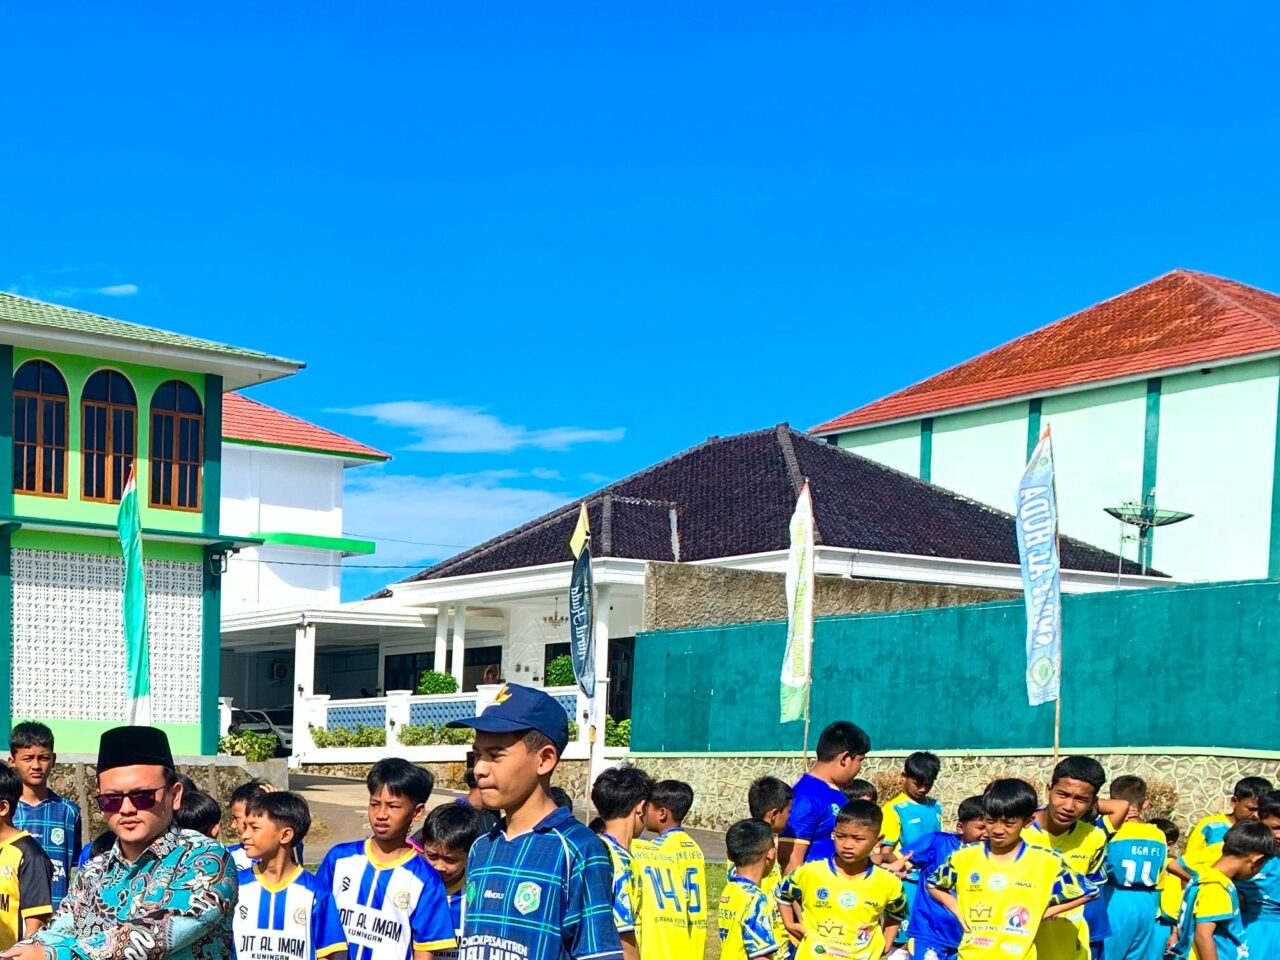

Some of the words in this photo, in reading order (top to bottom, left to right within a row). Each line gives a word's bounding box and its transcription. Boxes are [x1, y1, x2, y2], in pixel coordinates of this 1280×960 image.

[339, 908, 354, 926] DIT
[356, 912, 367, 929] AL
[372, 916, 403, 943] IMAM
[260, 936, 273, 951] AL
[278, 937, 305, 959] IMAM
